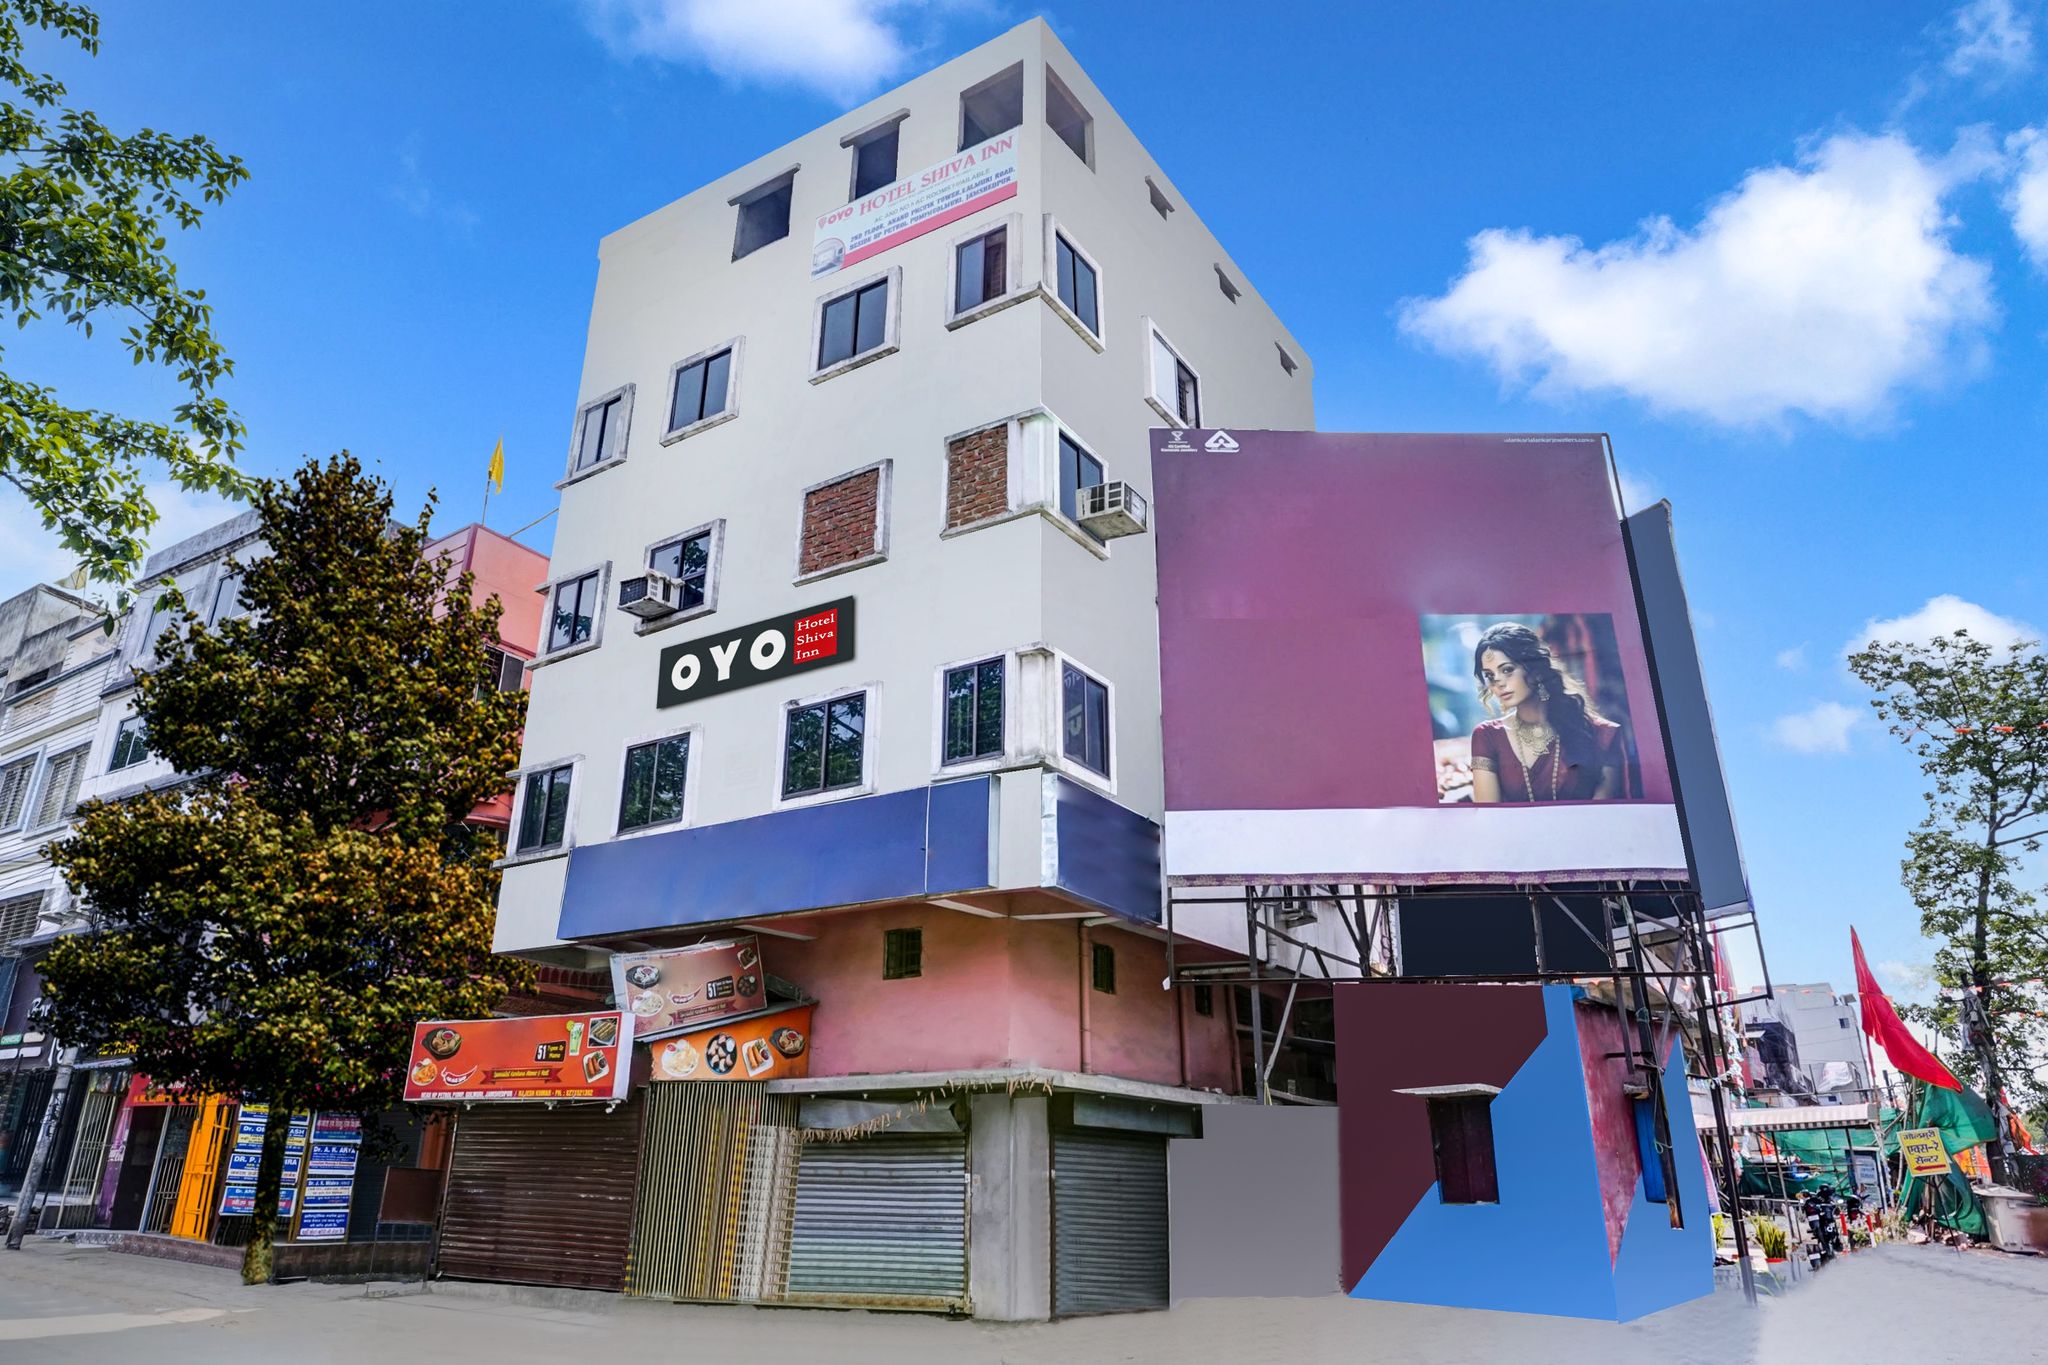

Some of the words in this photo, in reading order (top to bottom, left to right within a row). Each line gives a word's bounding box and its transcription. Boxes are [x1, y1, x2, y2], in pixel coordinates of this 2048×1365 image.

[828, 207, 853, 225] OYO
[859, 181, 914, 217] HOTEL
[922, 153, 976, 188] SHIVA
[981, 136, 1013, 161] INN
[797, 613, 835, 632] Hotel
[796, 631, 834, 646] Shiva
[671, 629, 786, 691] OYO
[796, 648, 820, 660] Inn
[707, 982, 717, 998] 51
[537, 1045, 547, 1060] 51
[233, 1155, 248, 1163] DR.
